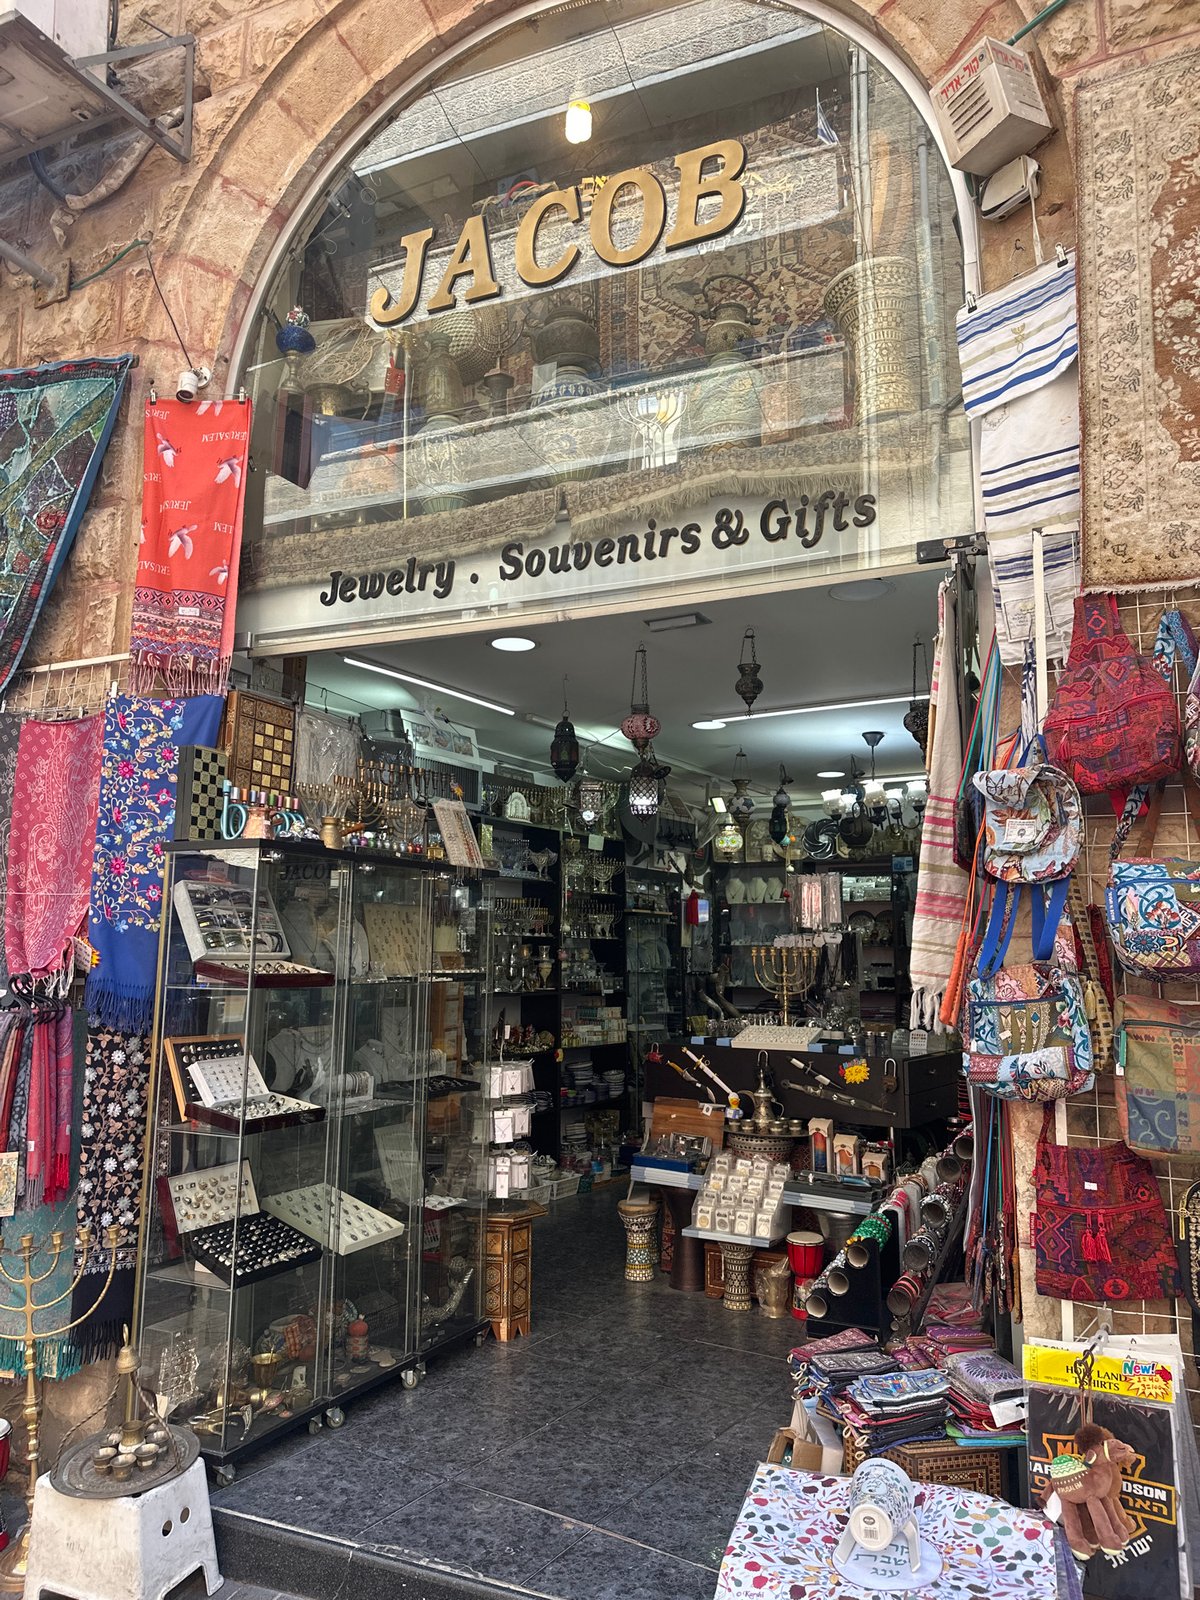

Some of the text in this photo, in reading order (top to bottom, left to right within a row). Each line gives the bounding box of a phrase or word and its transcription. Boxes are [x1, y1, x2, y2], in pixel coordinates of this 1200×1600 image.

[941, 56, 980, 99] קול-אדיר
[370, 139, 749, 327] JACOB
[320, 557, 455, 607] Jewelry
[499, 519, 702, 582] Souvenirs
[712, 508, 750, 550] &
[760, 490, 877, 549] Gifts
[1123, 1360, 1156, 1375] New!
[870, 1567, 900, 1578] ענג
